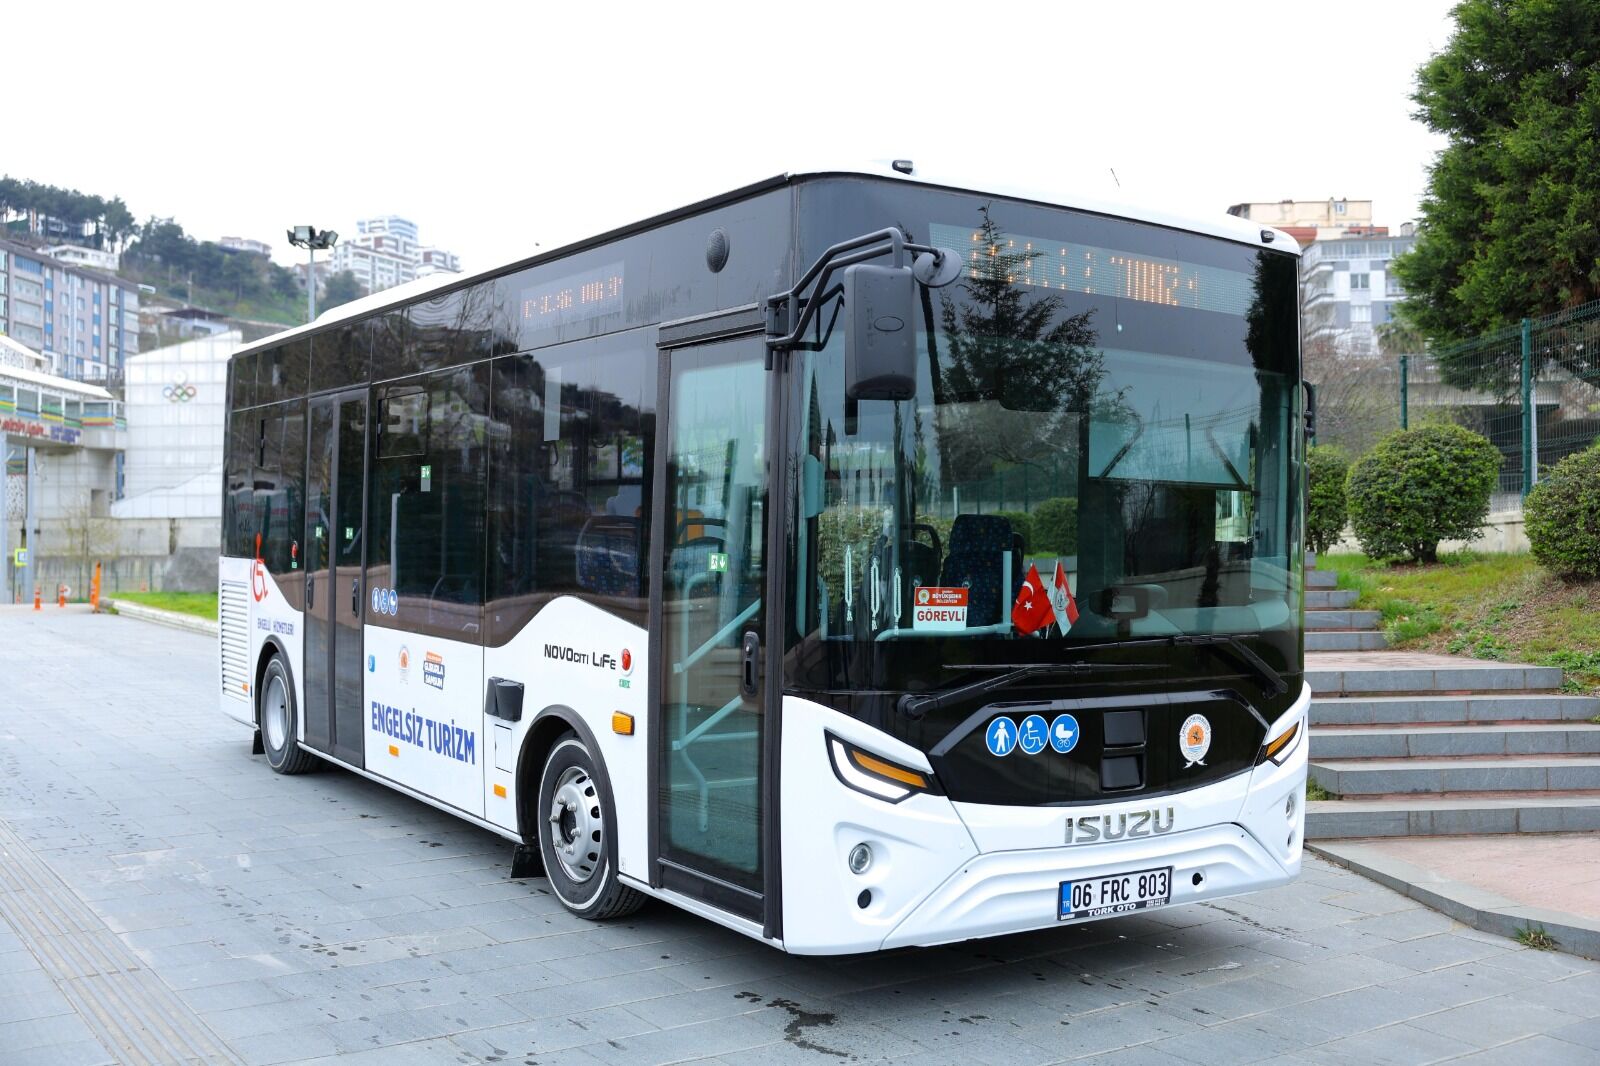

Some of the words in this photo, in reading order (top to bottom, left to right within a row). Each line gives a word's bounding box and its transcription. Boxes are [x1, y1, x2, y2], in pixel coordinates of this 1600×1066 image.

[917, 608, 965, 622] GÖREVLİ
[371, 700, 424, 748] ENGELSİZ
[425, 719, 476, 765] TURİZM
[1064, 807, 1174, 844] ISUZU
[1072, 884, 1093, 909] 06
[1100, 877, 1131, 905] FRC
[1138, 872, 1167, 899] 803
[1117, 903, 1137, 912] OTO
